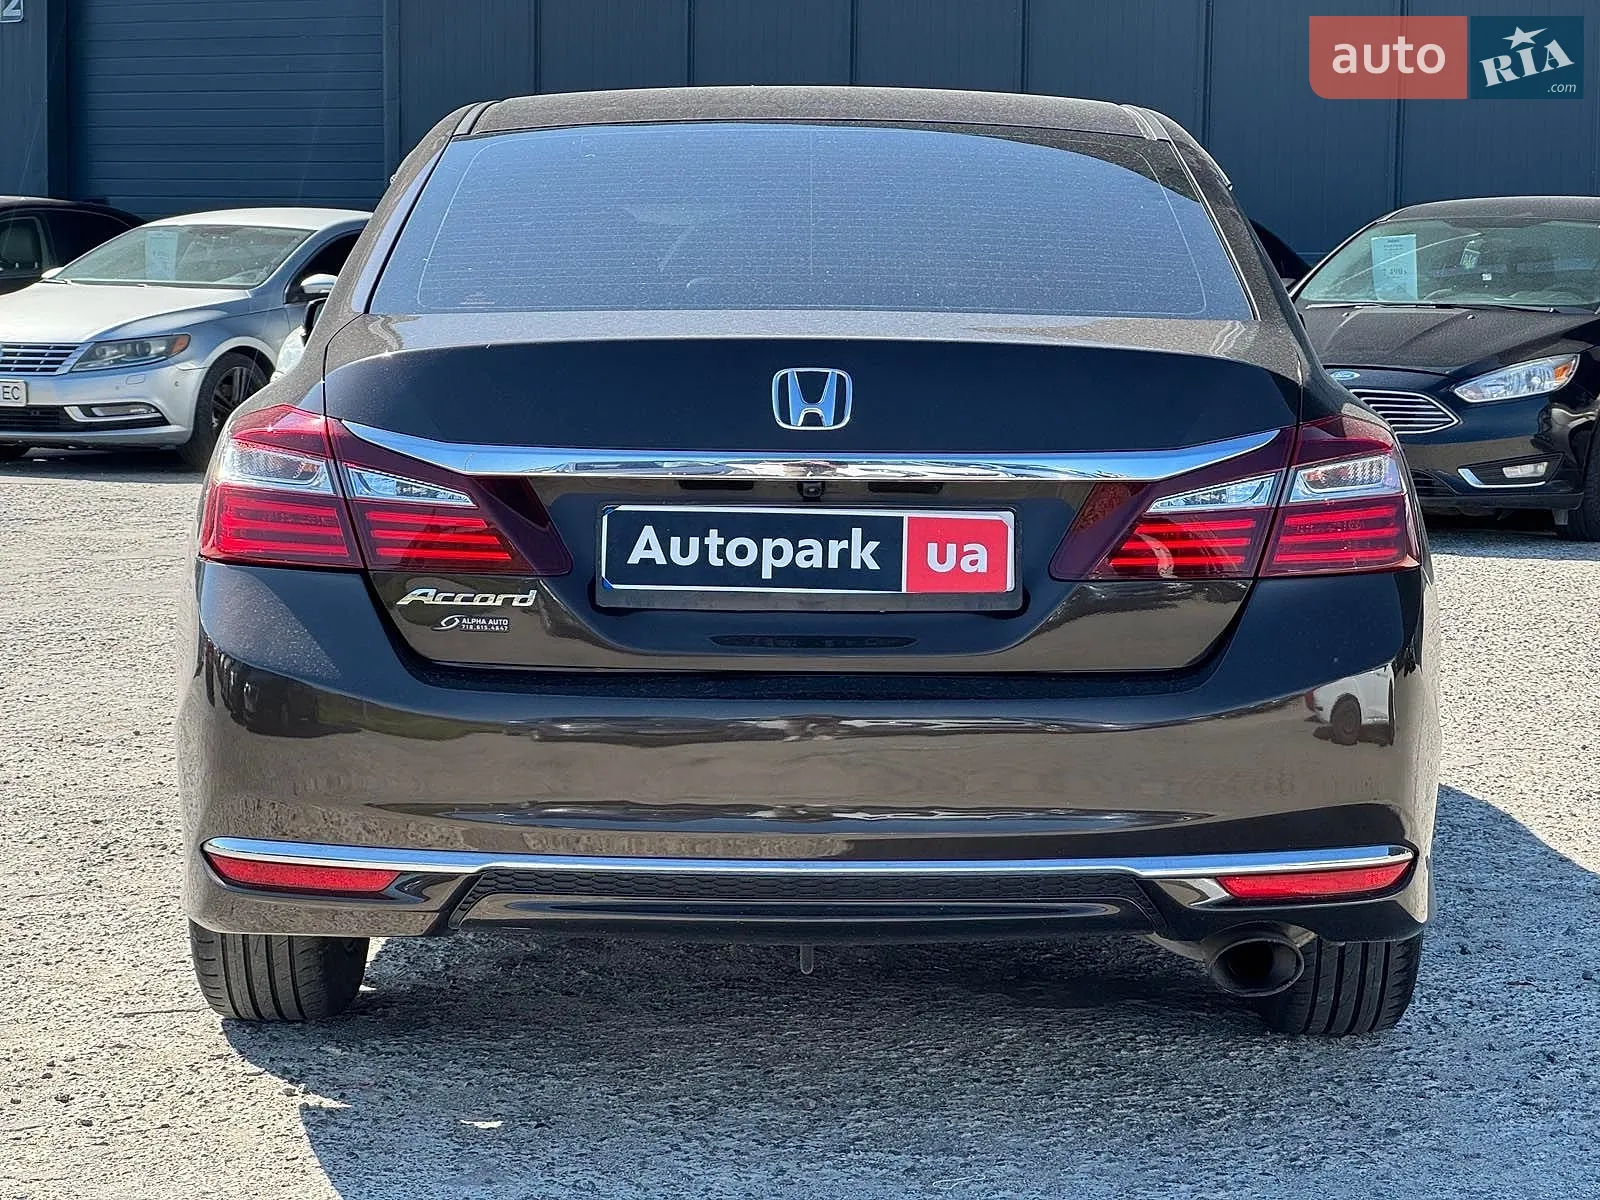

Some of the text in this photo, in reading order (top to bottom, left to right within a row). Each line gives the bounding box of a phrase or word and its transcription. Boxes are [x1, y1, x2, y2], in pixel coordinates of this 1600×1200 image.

[626, 525, 989, 580] Autopark ua
[396, 588, 538, 607] Accord
[461, 617, 487, 625] ALPHA
